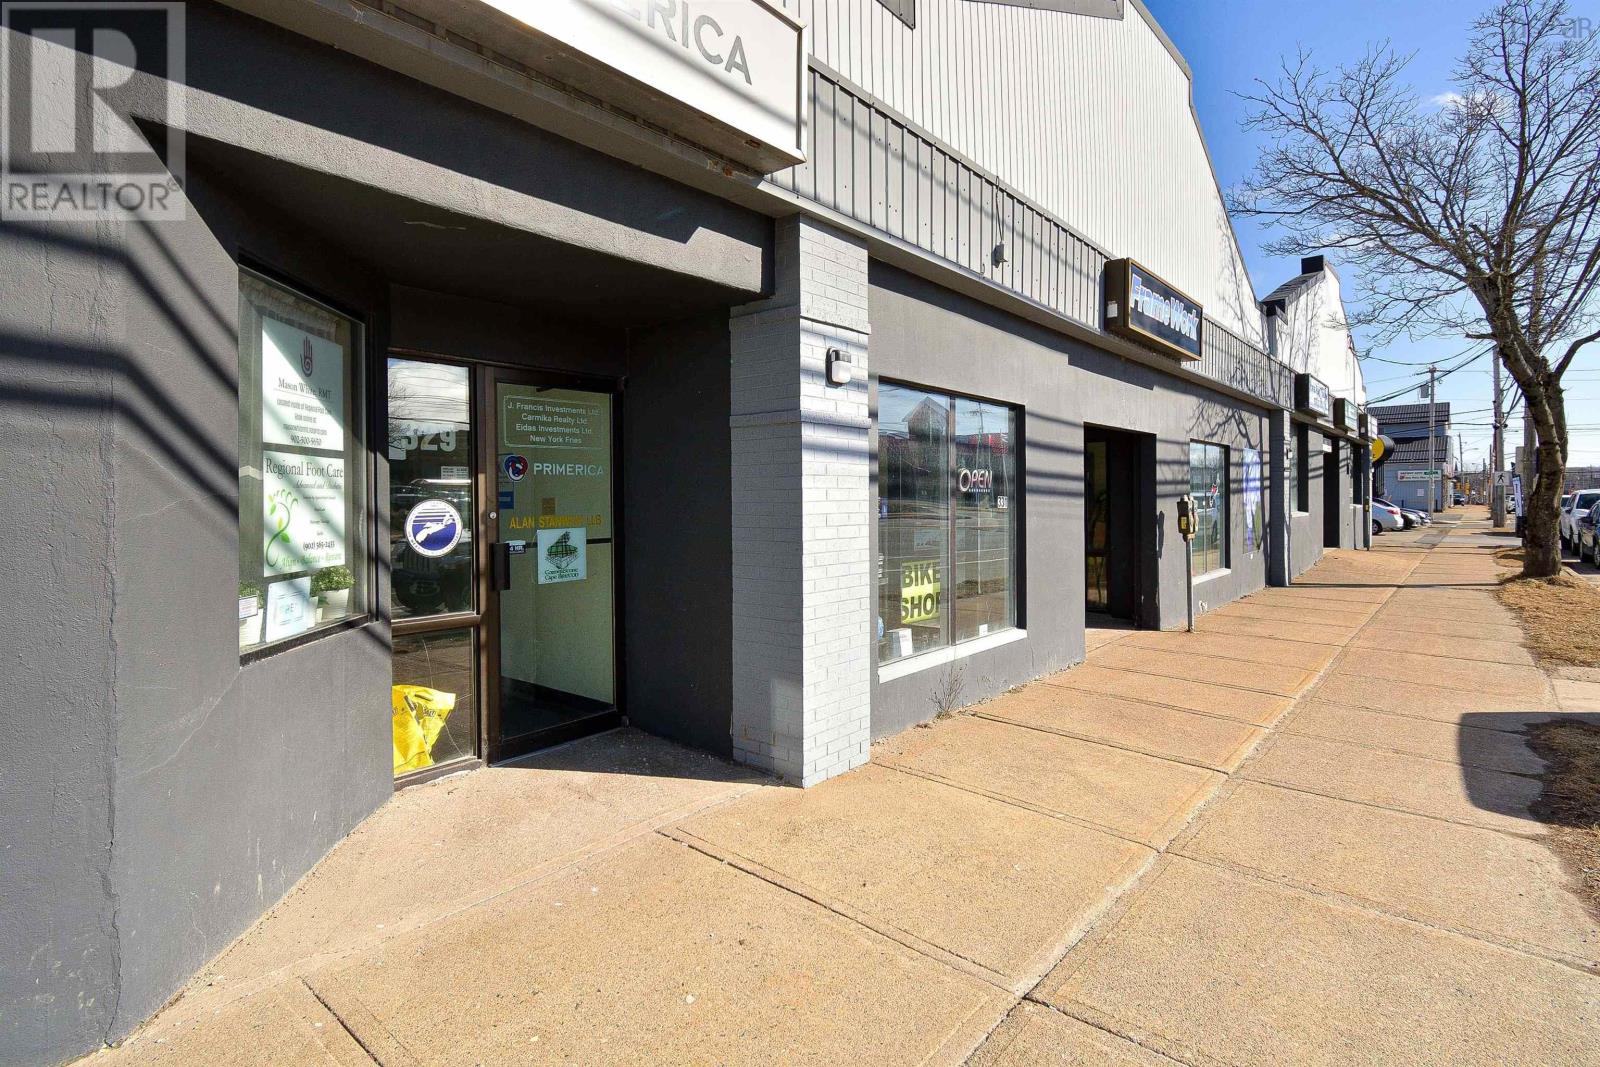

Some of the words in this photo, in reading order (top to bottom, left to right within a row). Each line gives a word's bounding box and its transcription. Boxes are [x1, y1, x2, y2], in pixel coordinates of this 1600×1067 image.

[278, 377, 298, 391] Mason
[516, 403, 544, 412] Francis
[545, 405, 586, 415] Investments
[553, 416, 576, 425] Realty
[516, 423, 537, 432] Eidas
[538, 424, 581, 434] Investments
[529, 434, 546, 443] New
[547, 435, 563, 443] York
[565, 436, 582, 444] Fries
[266, 458, 304, 480] Regional
[306, 461, 327, 478] Foot
[327, 463, 344, 479] Care
[533, 463, 604, 476] PRIMERICA
[959, 467, 993, 492] OPEN
[509, 516, 535, 529] ALAN
[902, 562, 941, 589] BIKE
